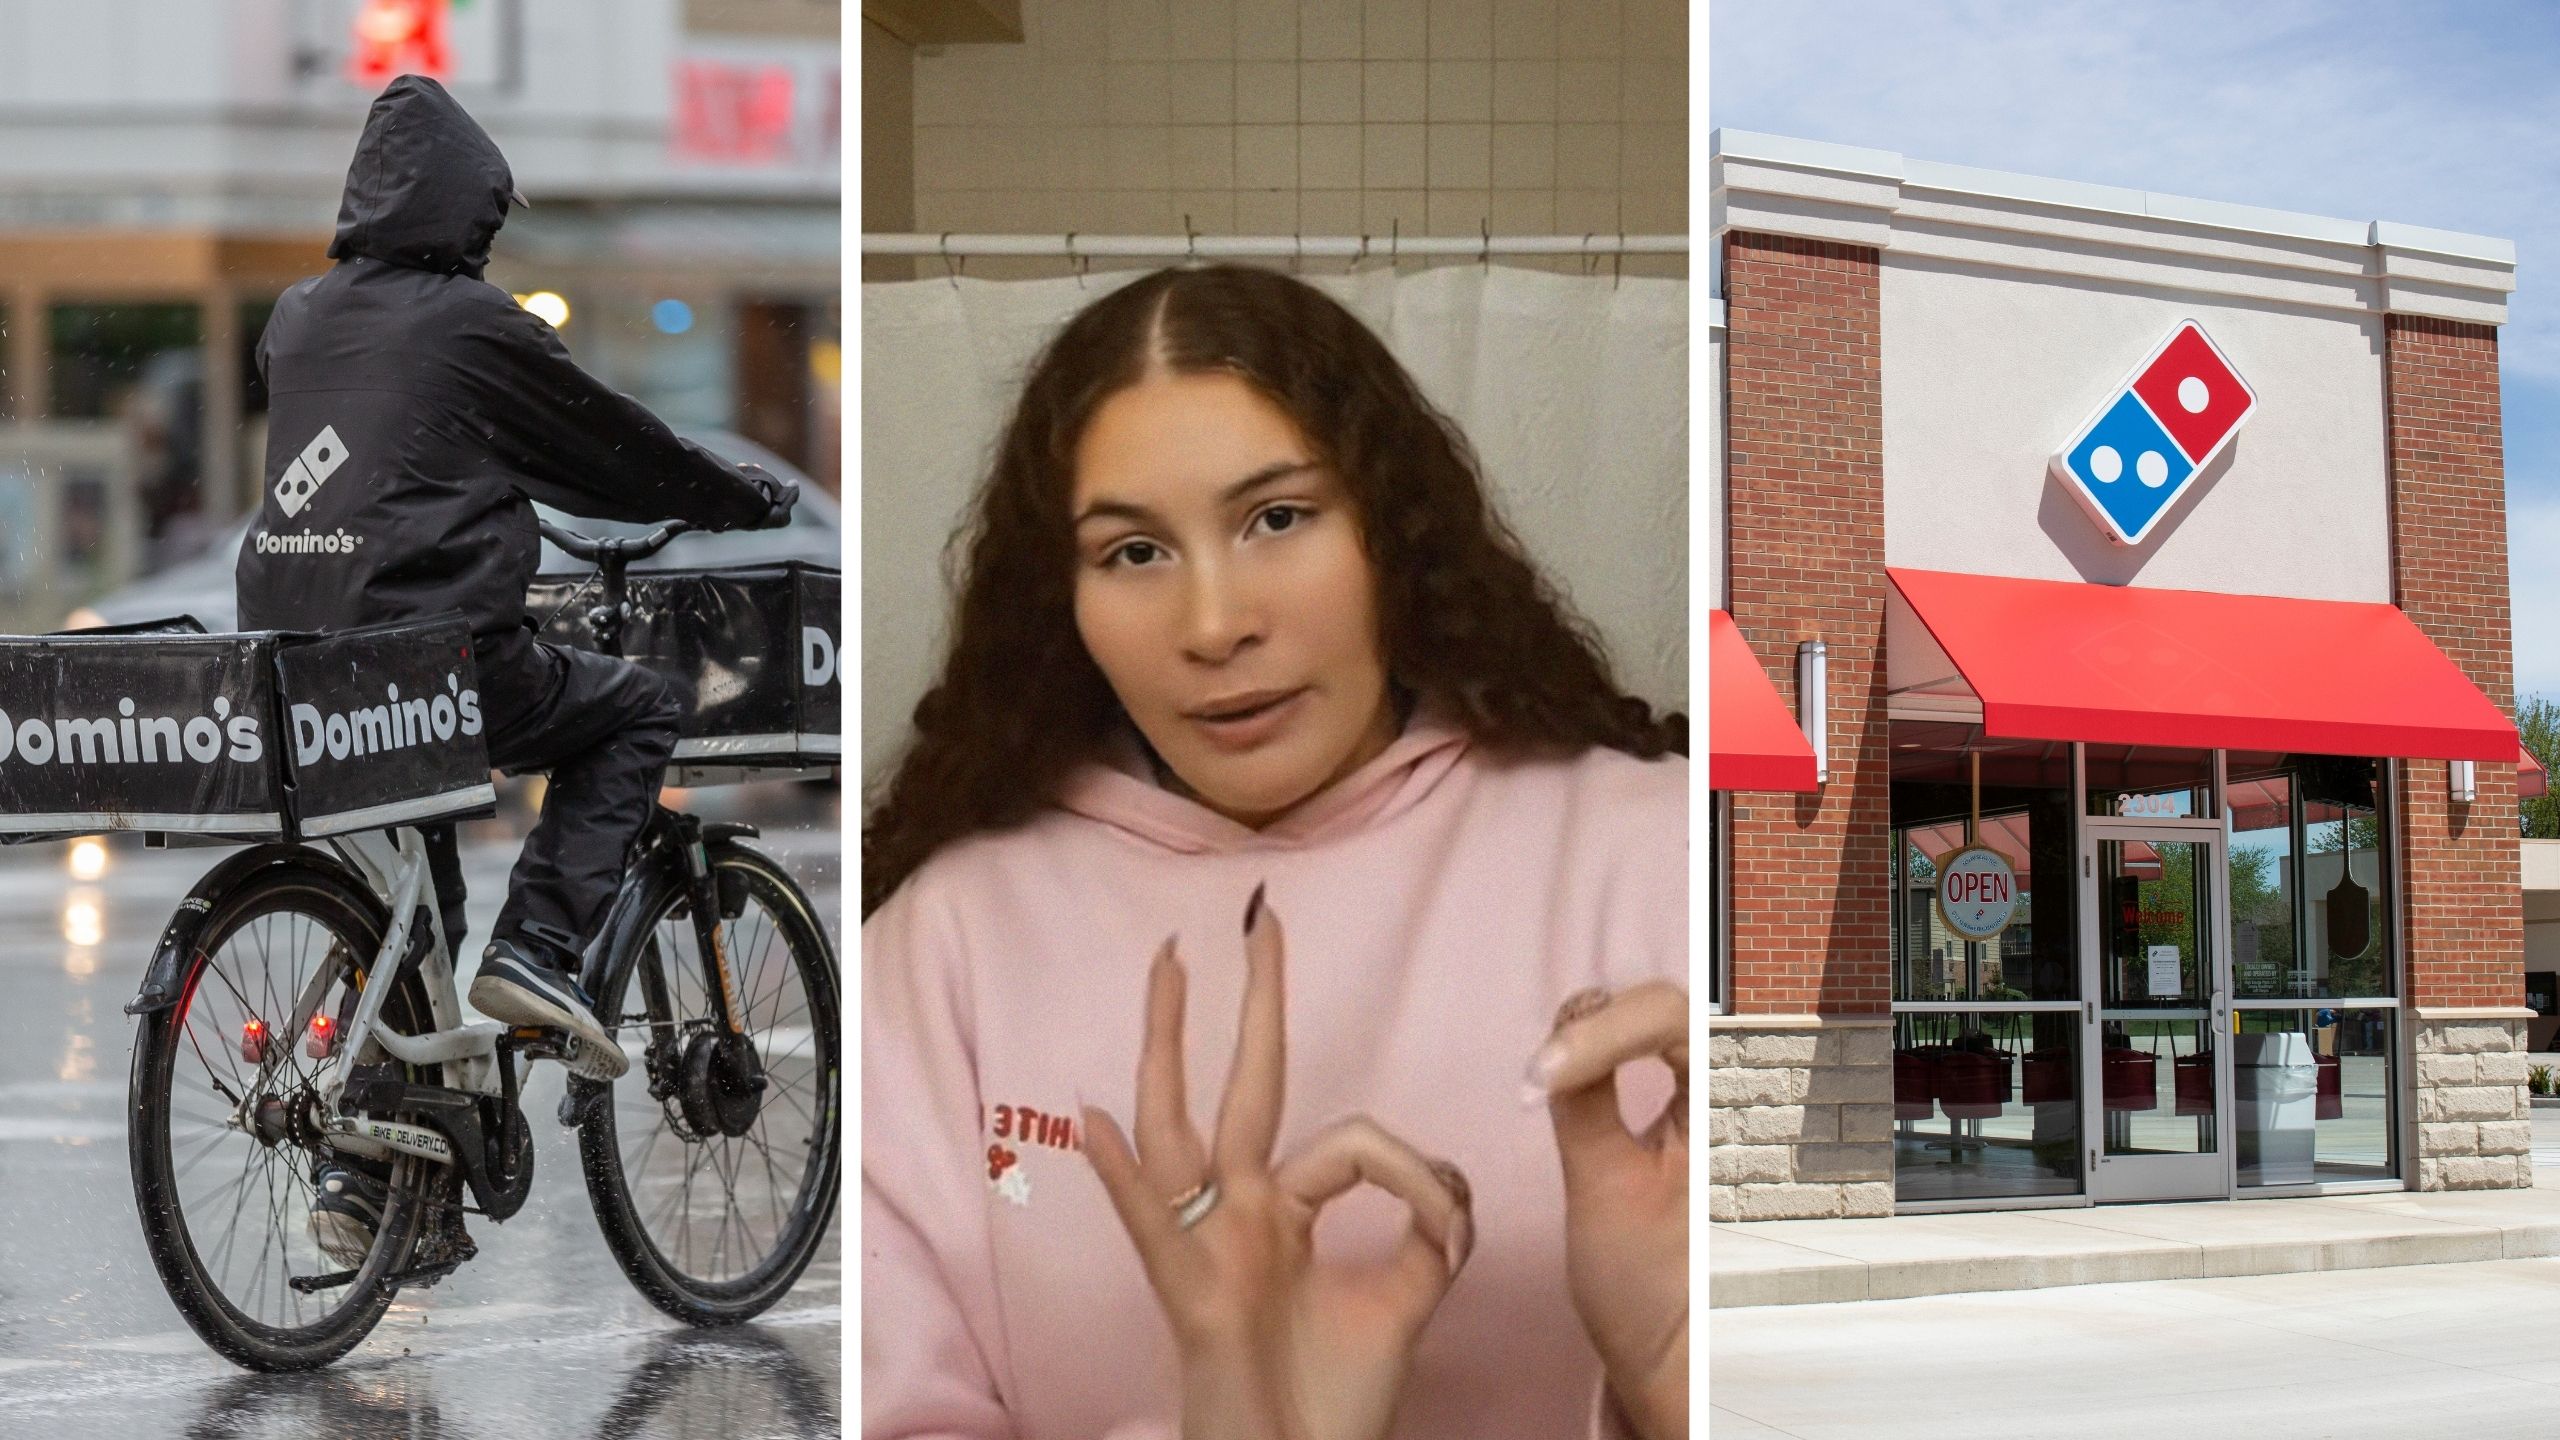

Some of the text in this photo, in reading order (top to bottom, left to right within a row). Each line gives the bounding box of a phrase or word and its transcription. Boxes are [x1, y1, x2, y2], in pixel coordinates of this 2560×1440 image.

[256, 527, 355, 554] Domino's
[802, 626, 841, 686] D
[0, 696, 263, 765] omino's
[291, 672, 483, 767] Domino's
[2118, 794, 2175, 813] 2304
[1947, 871, 2008, 903] OPEN
